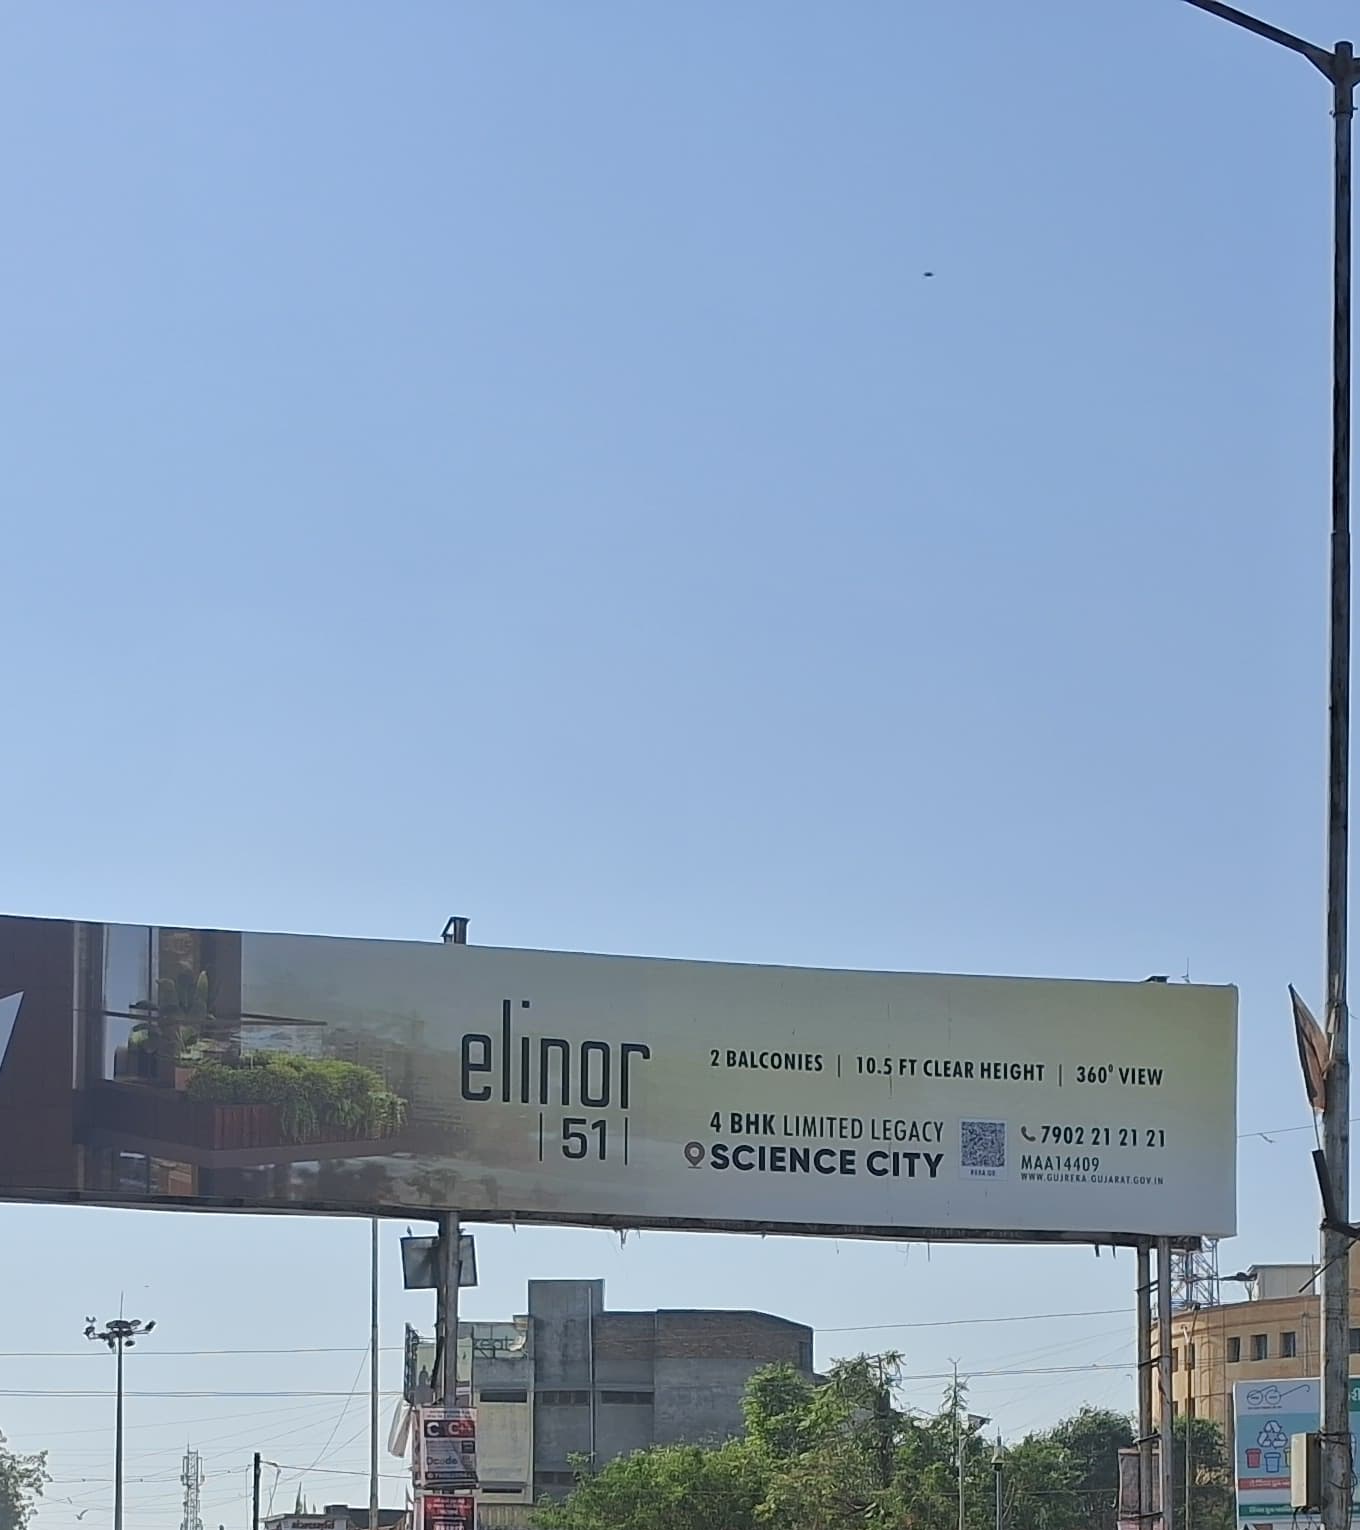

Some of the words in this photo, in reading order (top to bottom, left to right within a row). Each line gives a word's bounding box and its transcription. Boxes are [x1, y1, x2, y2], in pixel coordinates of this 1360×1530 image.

[461, 999, 651, 1109] elinor
[710, 1049, 720, 1067] 2
[726, 1050, 823, 1072] BALCONIES
[856, 1056, 893, 1075] 10.5
[899, 1058, 917, 1077] FT
[923, 1059, 974, 1079] CLEAR
[980, 1062, 1045, 1082] HEIGHT
[1118, 1067, 1164, 1086] VIEW
[561, 1117, 607, 1161] 51
[710, 1111, 722, 1133] 4
[730, 1112, 776, 1135] BHK
[783, 1114, 863, 1139] LIMITED
[871, 1118, 944, 1142] LEGACY
[1040, 1125, 1085, 1145] 7902
[1091, 1127, 1110, 1146] 21
[1118, 1128, 1138, 1147] 21
[1146, 1129, 1166, 1148] 21
[710, 1143, 857, 1175] SCIENCE
[866, 1150, 945, 1178] CITY
[1020, 1154, 1100, 1172] MAA14409
